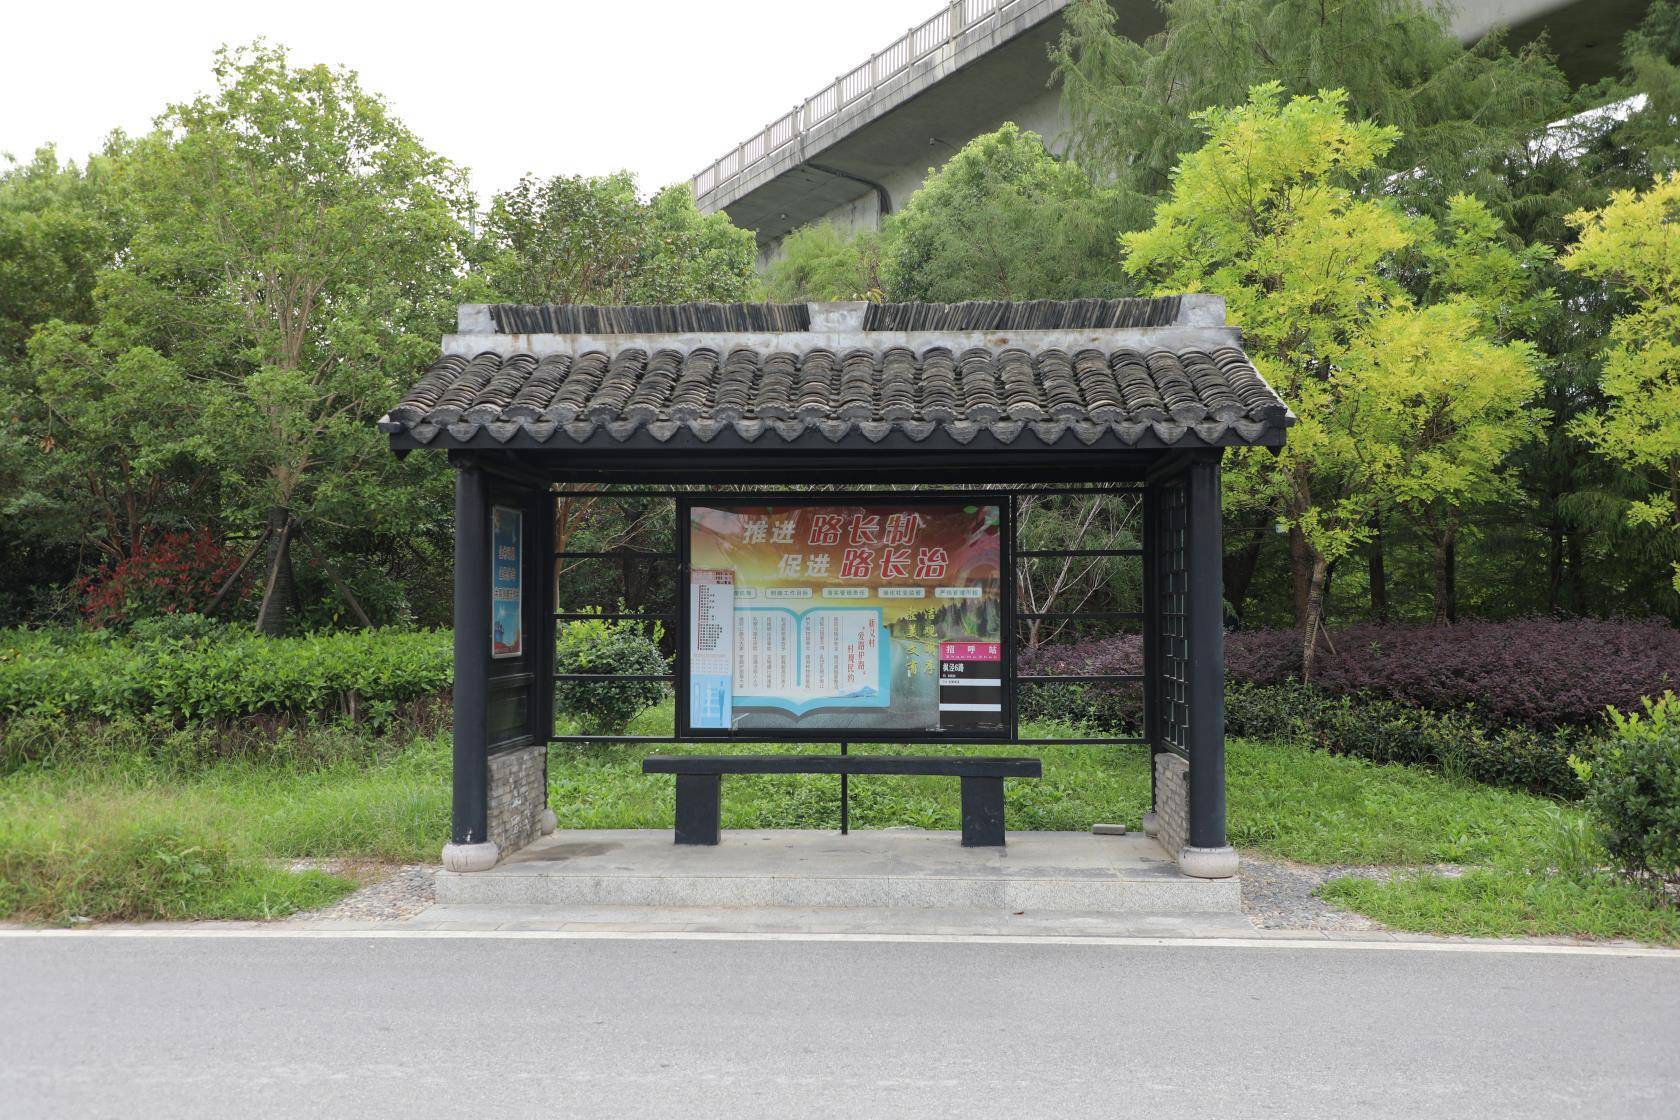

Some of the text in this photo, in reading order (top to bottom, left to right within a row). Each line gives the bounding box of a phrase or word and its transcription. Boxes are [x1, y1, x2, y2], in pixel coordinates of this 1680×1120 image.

[743, 514, 920, 546] 推进 路长制
[777, 548, 948, 579] 促进 路长治
[946, 644, 997, 655] 招呼站
